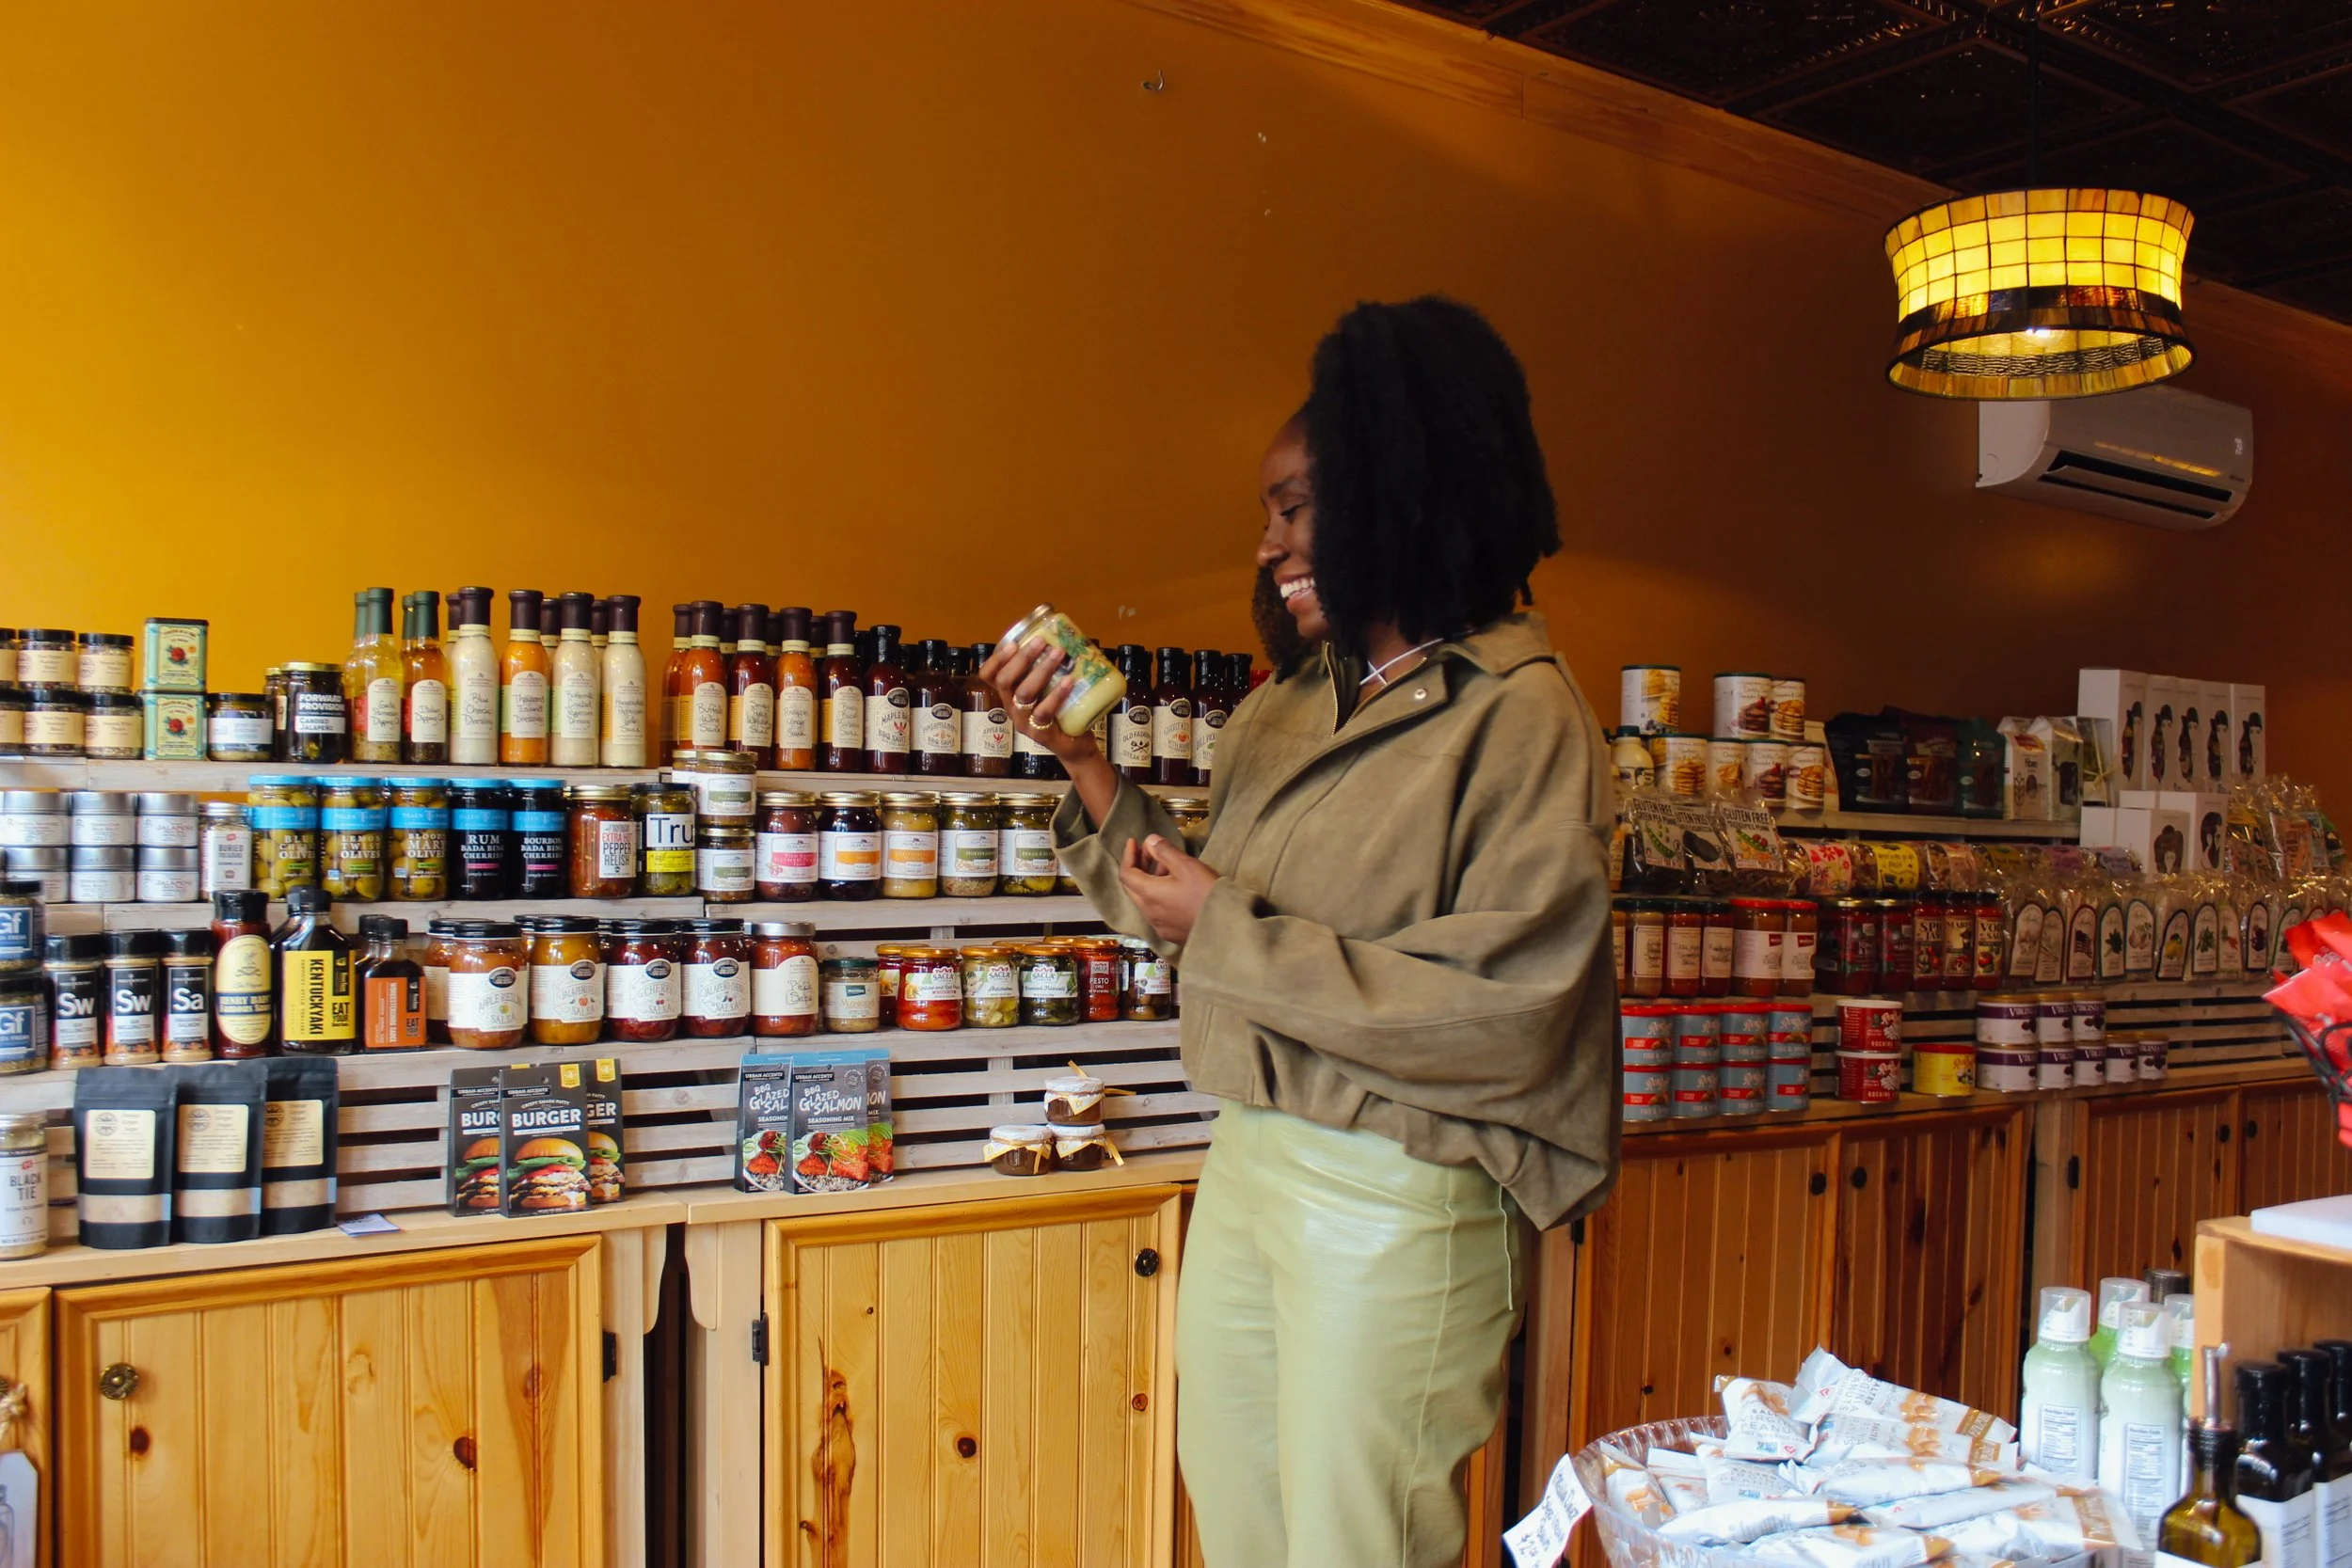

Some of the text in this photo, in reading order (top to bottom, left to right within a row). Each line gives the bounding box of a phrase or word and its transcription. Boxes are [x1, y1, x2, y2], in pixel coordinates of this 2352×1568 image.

[1122, 734, 1134, 742] OLD
[1633, 800, 1674, 816] GLUTEN FREE
[1724, 807, 1770, 825] GLUTEN FREE
[468, 834, 501, 845] RUM
[602, 832, 622, 843] EXTRA
[341, 850, 381, 859] OLIVES
[603, 843, 631, 855] PEPPER
[604, 854, 629, 866] RELISH
[116, 989, 151, 1013] Sw
[173, 987, 204, 1011] Sa
[309, 958, 325, 1036] KENTUCKYAKI
[58, 992, 95, 1018] Sw
[332, 1002, 351, 1015] EAT
[571, 1006, 596, 1016] SALSA
[647, 1004, 672, 1015] SALSA
[715, 1003, 739, 1014] SALSA
[406, 1018, 420, 1027] EAT
[489, 1014, 516, 1025] SALSA
[754, 1083, 771, 1096] BBQ
[803, 1085, 821, 1097] BBQ
[749, 1088, 790, 1111] GLAZED
[799, 1089, 840, 1112] GLAZED
[813, 1095, 863, 1116] SALMON
[586, 1101, 617, 1117] GER
[763, 1099, 789, 1115] SAL
[461, 1110, 501, 1128] BUR
[511, 1108, 581, 1128] BURGER
[807, 1116, 843, 1124] SEASONING
[9, 1172, 41, 1187] BLACK
[17, 1185, 37, 1201] TIE
